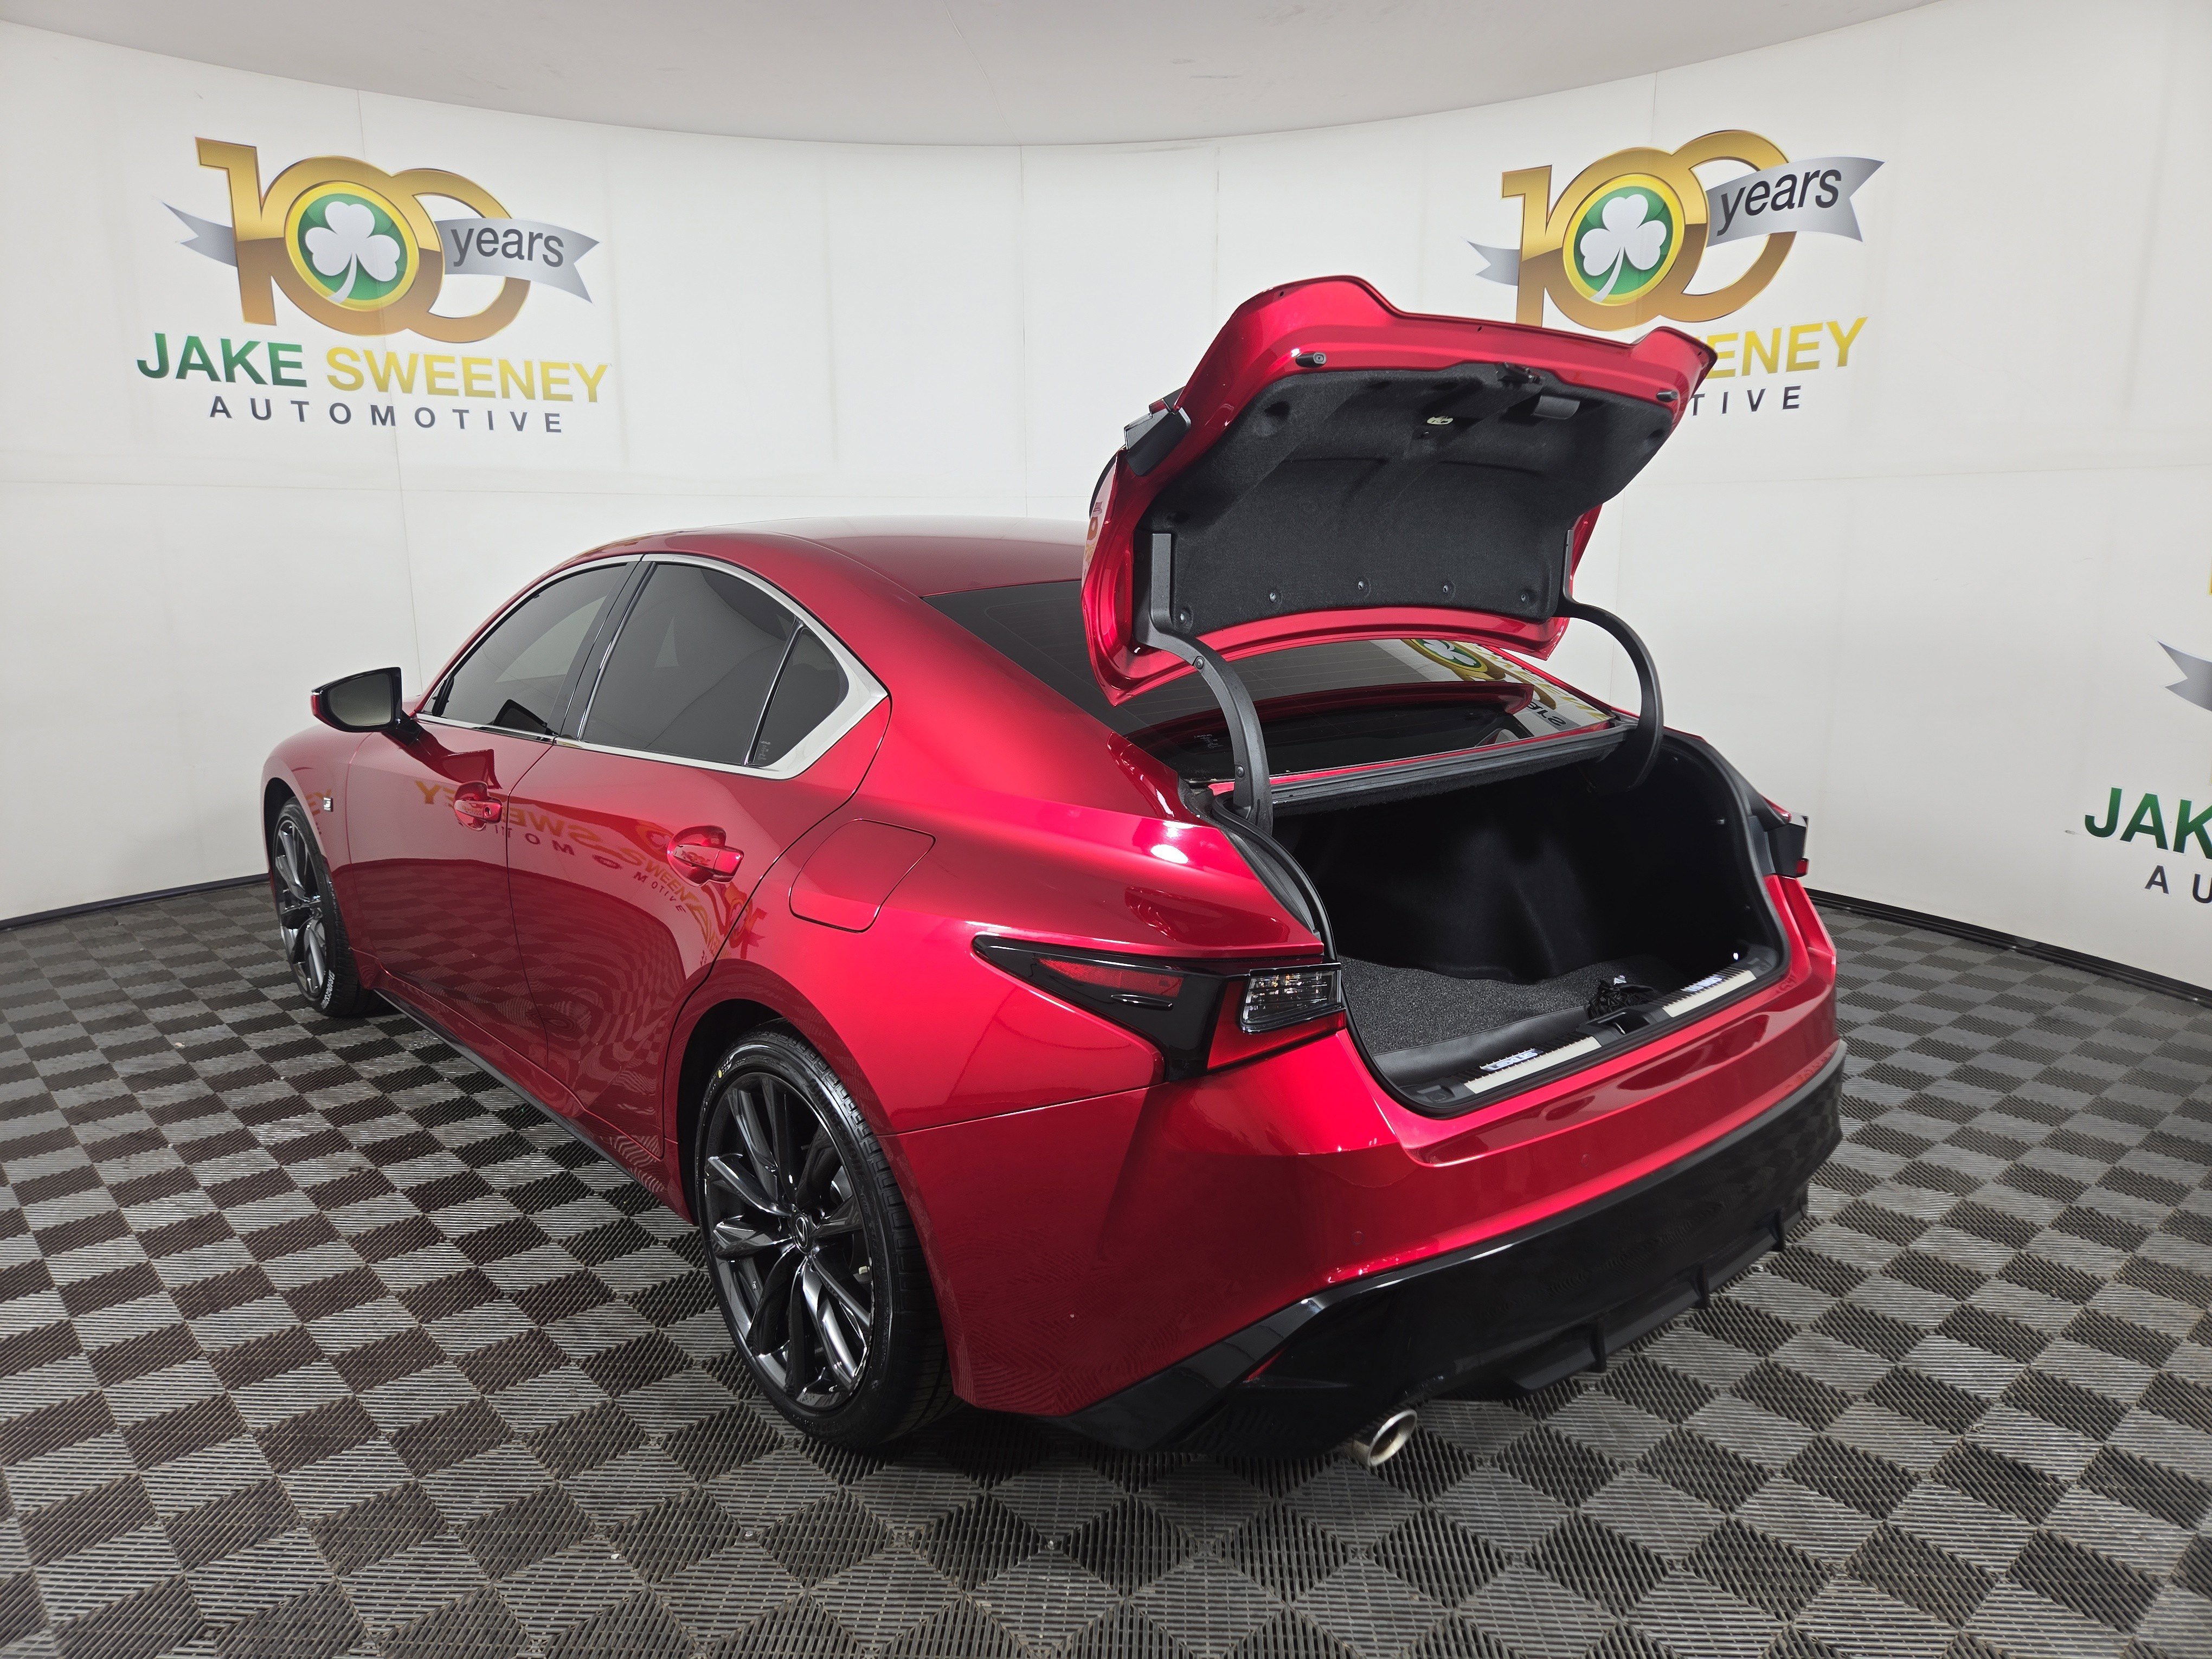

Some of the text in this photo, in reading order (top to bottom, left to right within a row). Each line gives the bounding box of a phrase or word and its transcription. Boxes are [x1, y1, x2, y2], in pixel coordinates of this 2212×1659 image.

[1716, 169, 1842, 236] years
[195, 137, 531, 343] 100
[450, 227, 564, 267] years
[136, 332, 608, 403] JAKE SWEENEY
[209, 395, 562, 434] AUTOMOTIVE
